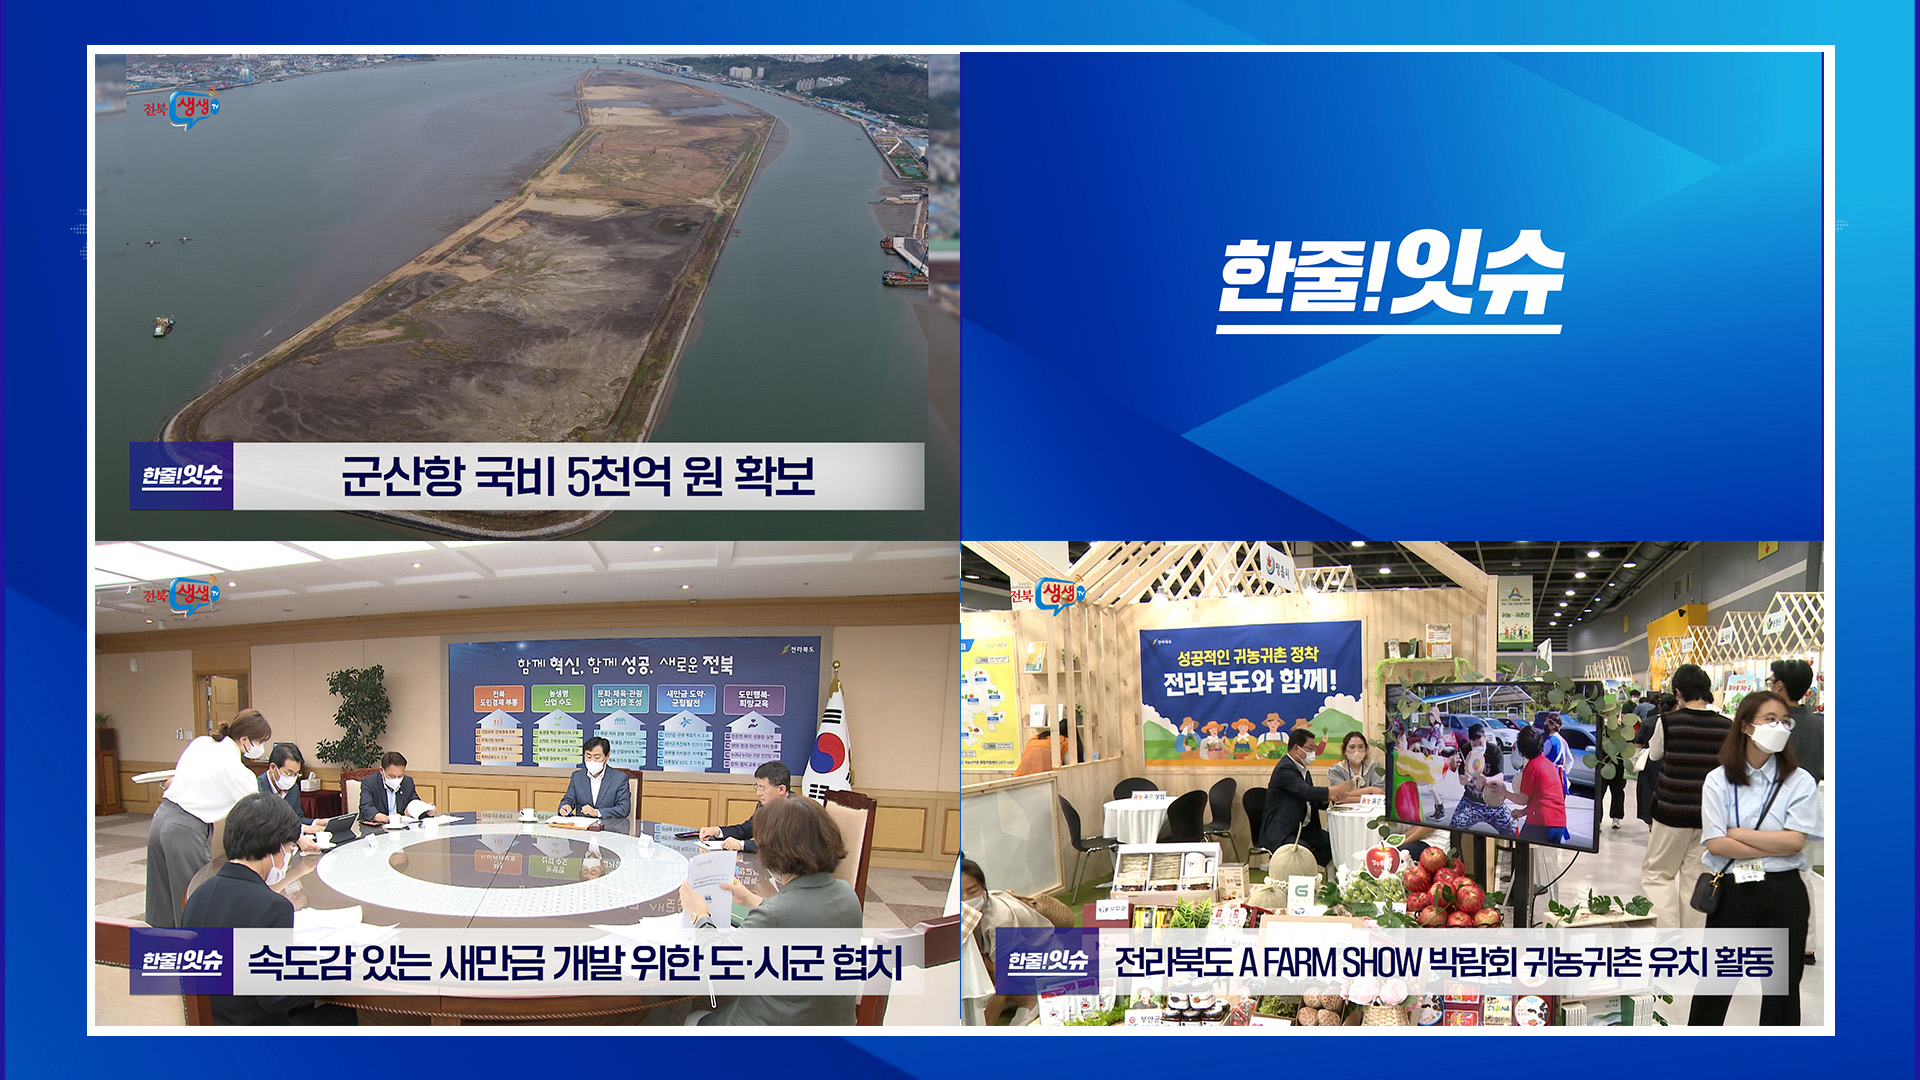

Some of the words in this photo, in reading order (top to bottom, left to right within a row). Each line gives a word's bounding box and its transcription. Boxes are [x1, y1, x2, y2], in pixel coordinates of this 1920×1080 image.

[1177, 649, 1231, 667] 성공적인
[1233, 647, 1288, 665] 귀농귀촌
[1290, 645, 1320, 663] 정착
[518, 657, 546, 675] 함께
[587, 656, 618, 674] 함께
[659, 657, 698, 673] 새로운
[702, 656, 733, 676] 전북
[1163, 668, 1275, 697] 전라북도와
[1279, 668, 1337, 694] 함께!
[666, 690, 688, 698] 새만금
[544, 698, 557, 706] 산업
[559, 698, 572, 706] 수도
[599, 698, 627, 707] 산업거점
[628, 698, 642, 707] 조성
